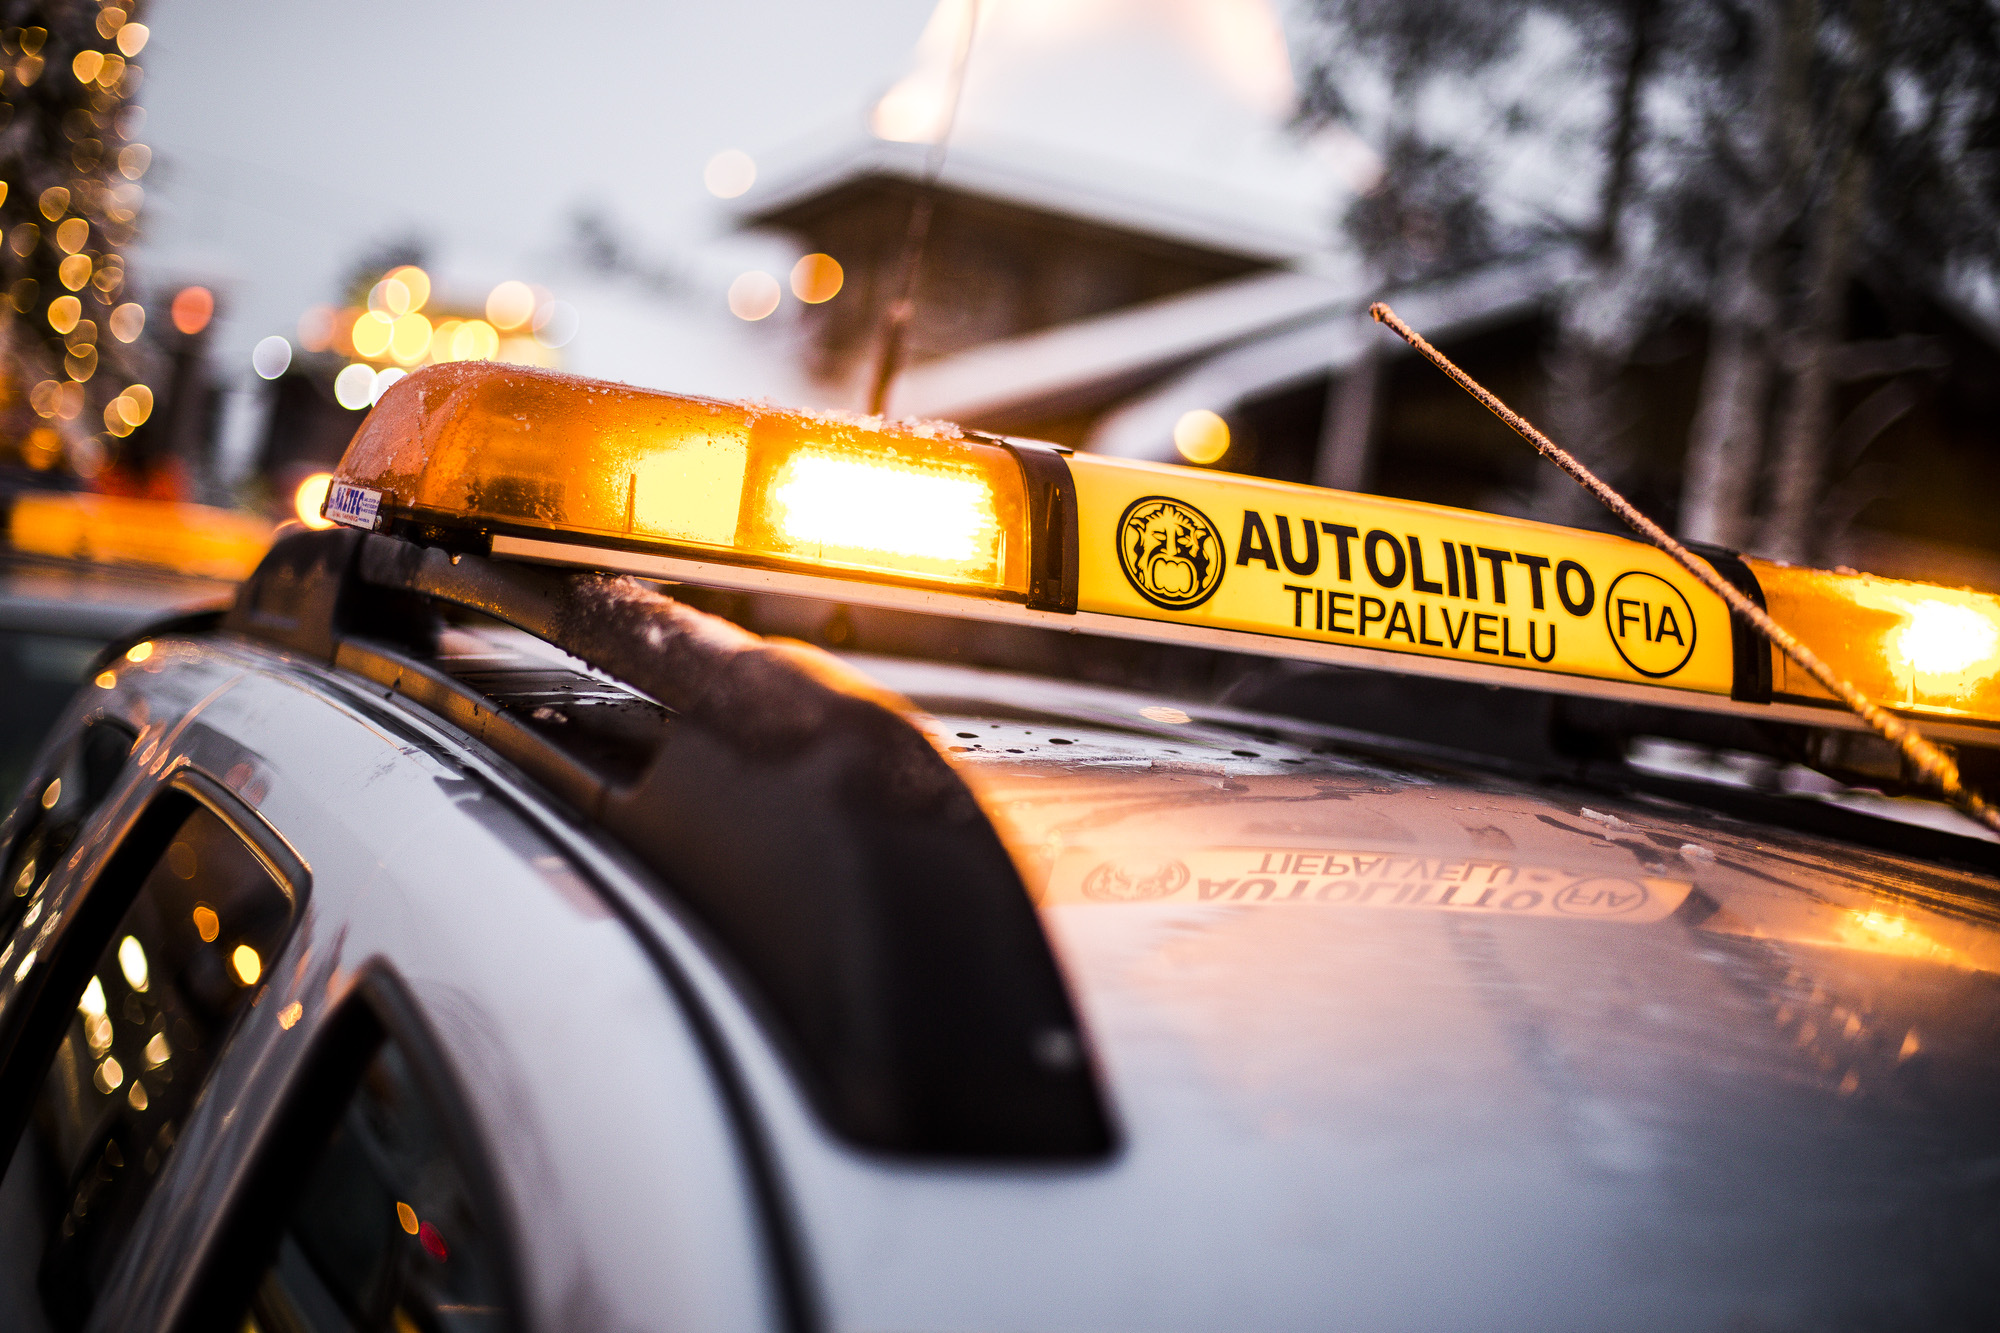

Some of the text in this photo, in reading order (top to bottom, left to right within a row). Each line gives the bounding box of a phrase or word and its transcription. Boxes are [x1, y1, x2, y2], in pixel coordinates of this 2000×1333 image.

[1236, 510, 1595, 616] AUTOLIITTO
[1284, 585, 1557, 663] TIEPALVELU
[1617, 600, 1685, 647] FIA
